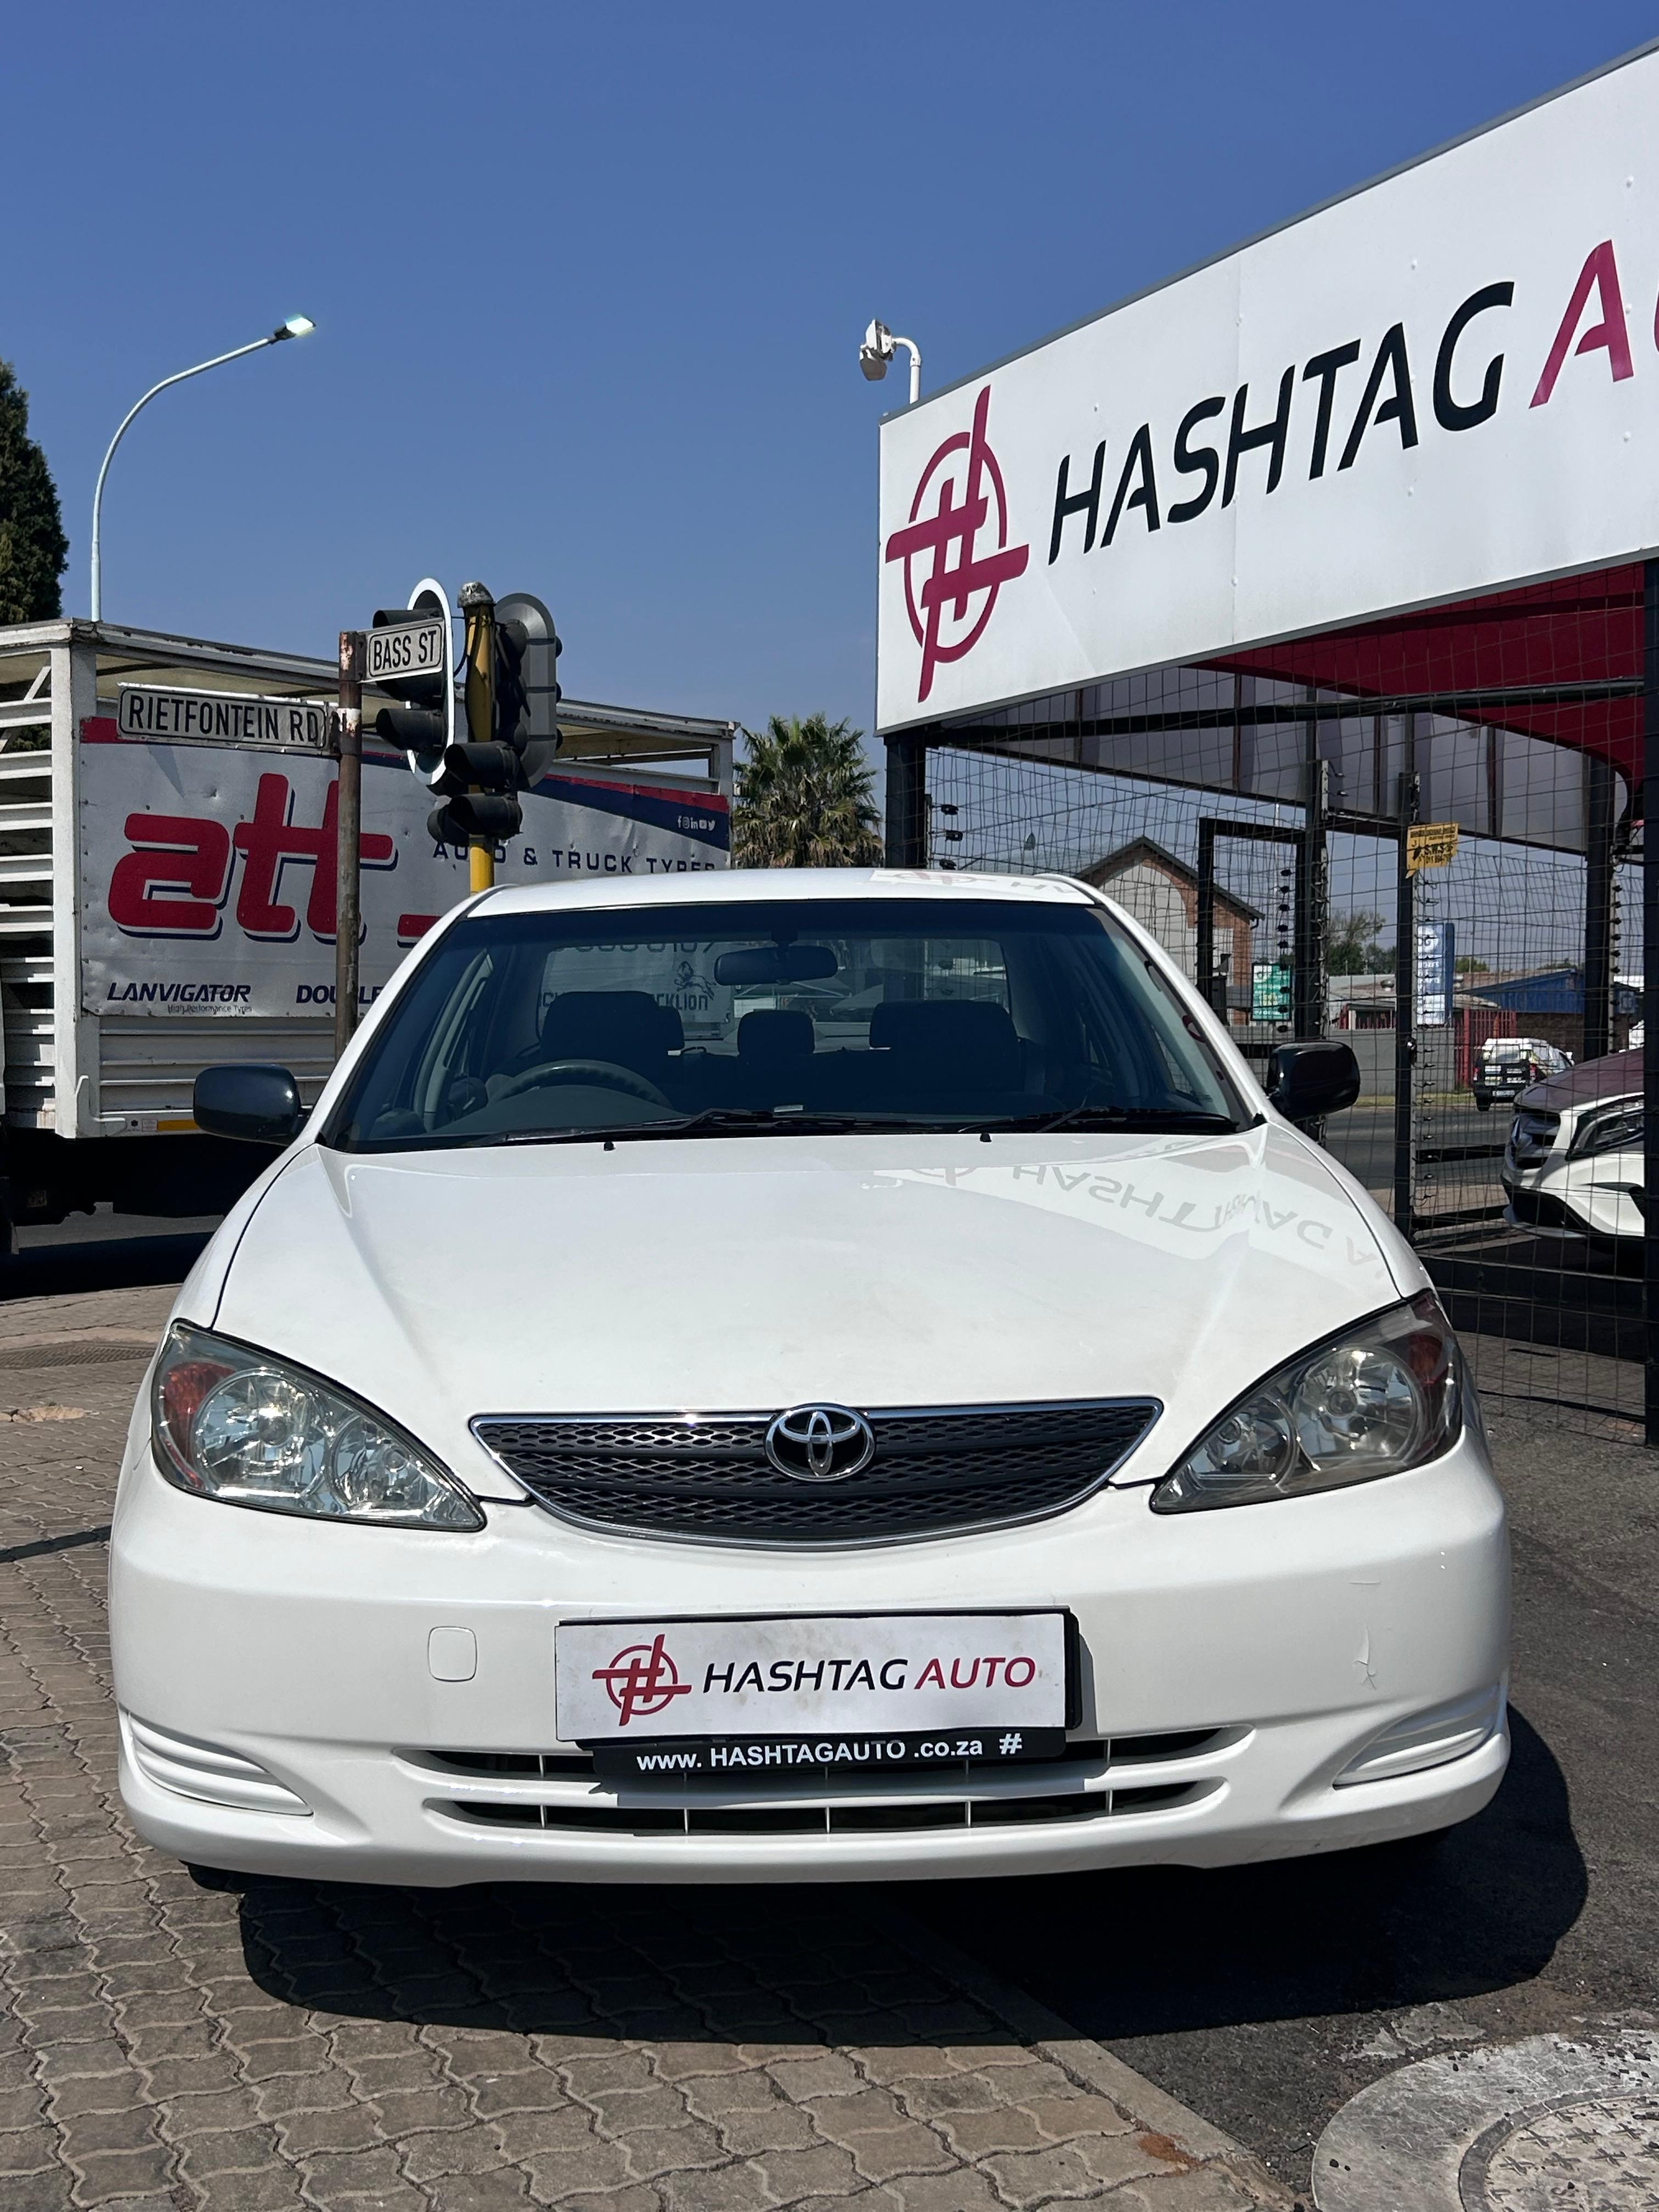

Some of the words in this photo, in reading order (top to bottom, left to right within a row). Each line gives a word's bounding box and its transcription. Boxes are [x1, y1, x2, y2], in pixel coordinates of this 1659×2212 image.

[1048, 280, 1515, 566] HASHTAG
[1528, 239, 1659, 409] A
[374, 635, 411, 670] BASS
[418, 630, 437, 663] ST
[129, 695, 279, 740] RIETFONTEIN
[290, 710, 319, 743] RD
[108, 772, 398, 941] att
[433, 842, 506, 864] AUO
[523, 848, 538, 865] &
[552, 850, 633, 873] TRUCK
[106, 982, 251, 1003] LANVIGATOR
[296, 984, 386, 1005] DOLE
[703, 1659, 909, 1694] HASHTAG
[913, 1657, 1036, 1690] AUTO
[636, 1753, 702, 1771] www.
[710, 1740, 906, 1767] HASHTAGAUTO
[913, 1739, 983, 1758] .co.za
[998, 1733, 1023, 1754] #
